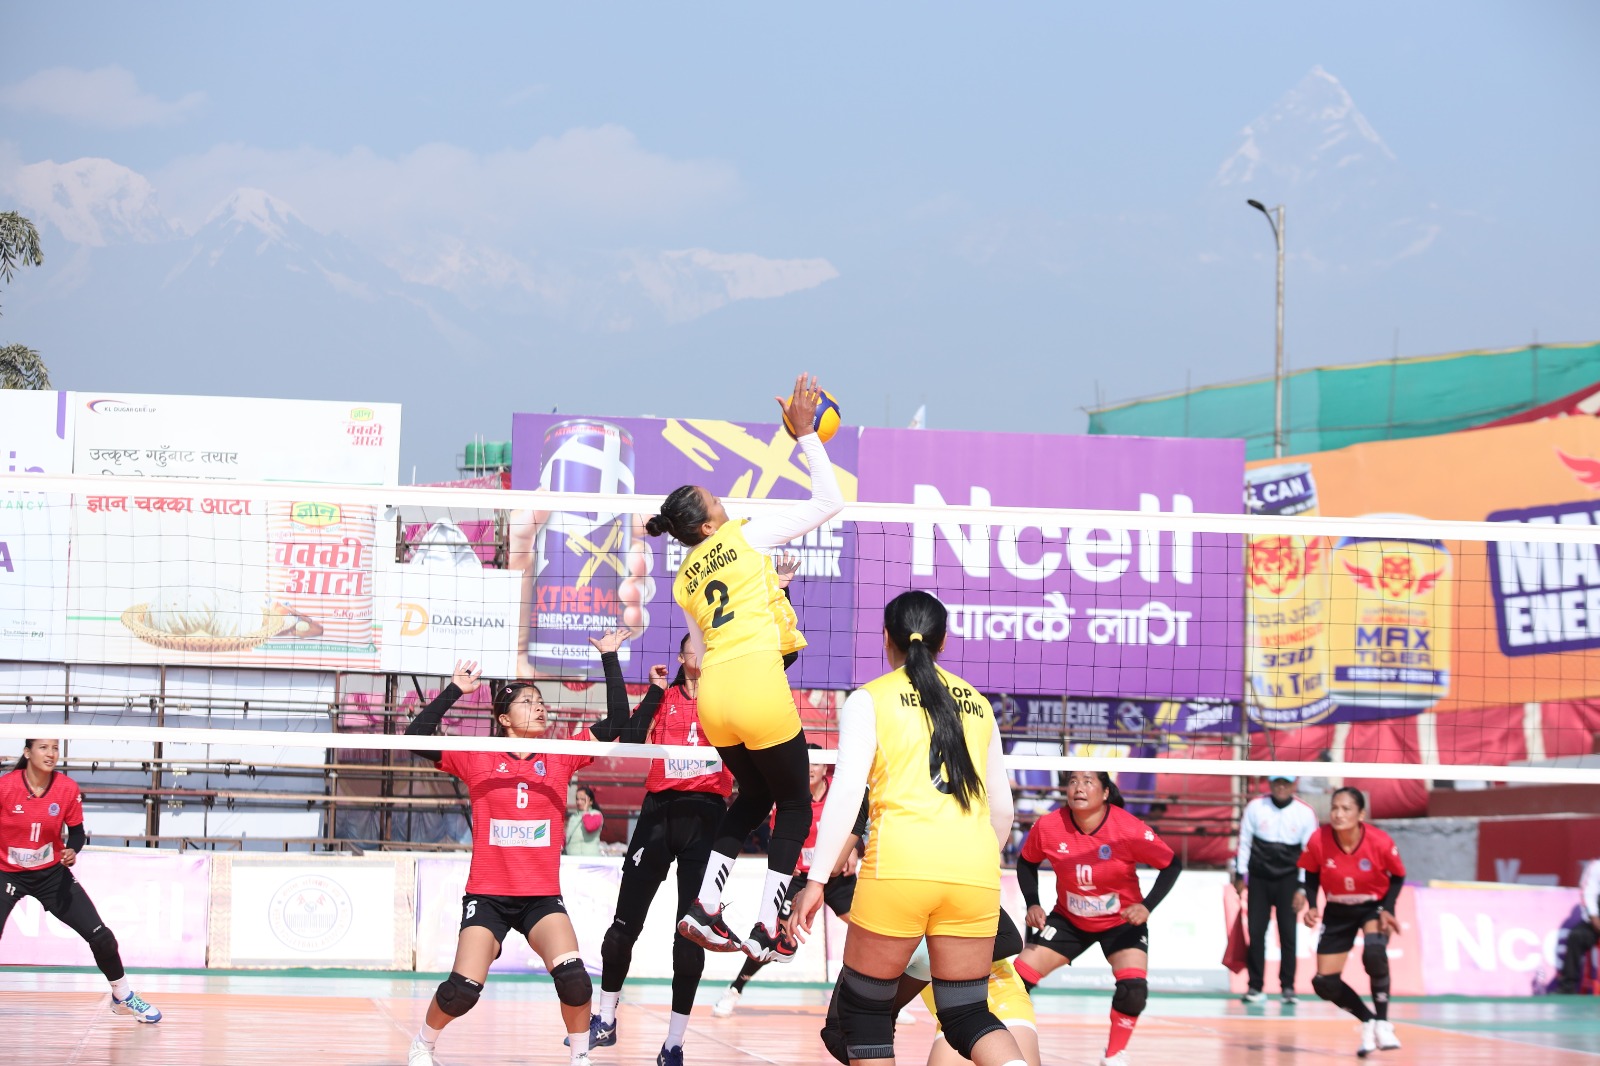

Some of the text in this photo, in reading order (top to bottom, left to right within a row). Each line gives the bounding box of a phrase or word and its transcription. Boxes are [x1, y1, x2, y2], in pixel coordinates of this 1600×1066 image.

[89, 448, 140, 465] उत्कृष्ट
[201, 450, 239, 464] तयार
[1262, 476, 1306, 503] CAN
[86, 495, 128, 513] ज्ञान
[200, 498, 251, 515] आटा
[912, 484, 1194, 584] Ncell
[274, 537, 366, 569] चक्की
[684, 561, 701, 580] TIP
[702, 542, 723, 565] TOP
[285, 569, 368, 596] आटा
[685, 577, 699, 597] NEW
[700, 548, 738, 580] DIAMOND
[704, 579, 735, 629] 2
[431, 613, 505, 629] DARSHAN
[538, 612, 580, 626] ENERGY
[582, 615, 617, 628] DRINK
[1085, 600, 1192, 647] लागि
[432, 625, 475, 637] Transport
[1356, 626, 1430, 651] MAX
[551, 645, 590, 658] CLASSIC
[1356, 650, 1432, 666] TIGER
[950, 686, 972, 699] OP
[1027, 700, 1110, 725] XTREME
[687, 721, 700, 747] 4
[516, 782, 529, 809] 6
[29, 822, 42, 843] 11
[492, 823, 534, 840] RUPSE
[496, 838, 528, 846] HOLIDAYS
[632, 846, 645, 867] 4
[1075, 863, 1093, 886] 10
[781, 900, 793, 916] 5
[1068, 895, 1105, 912] RUPSE
[1039, 924, 1058, 942] 10
